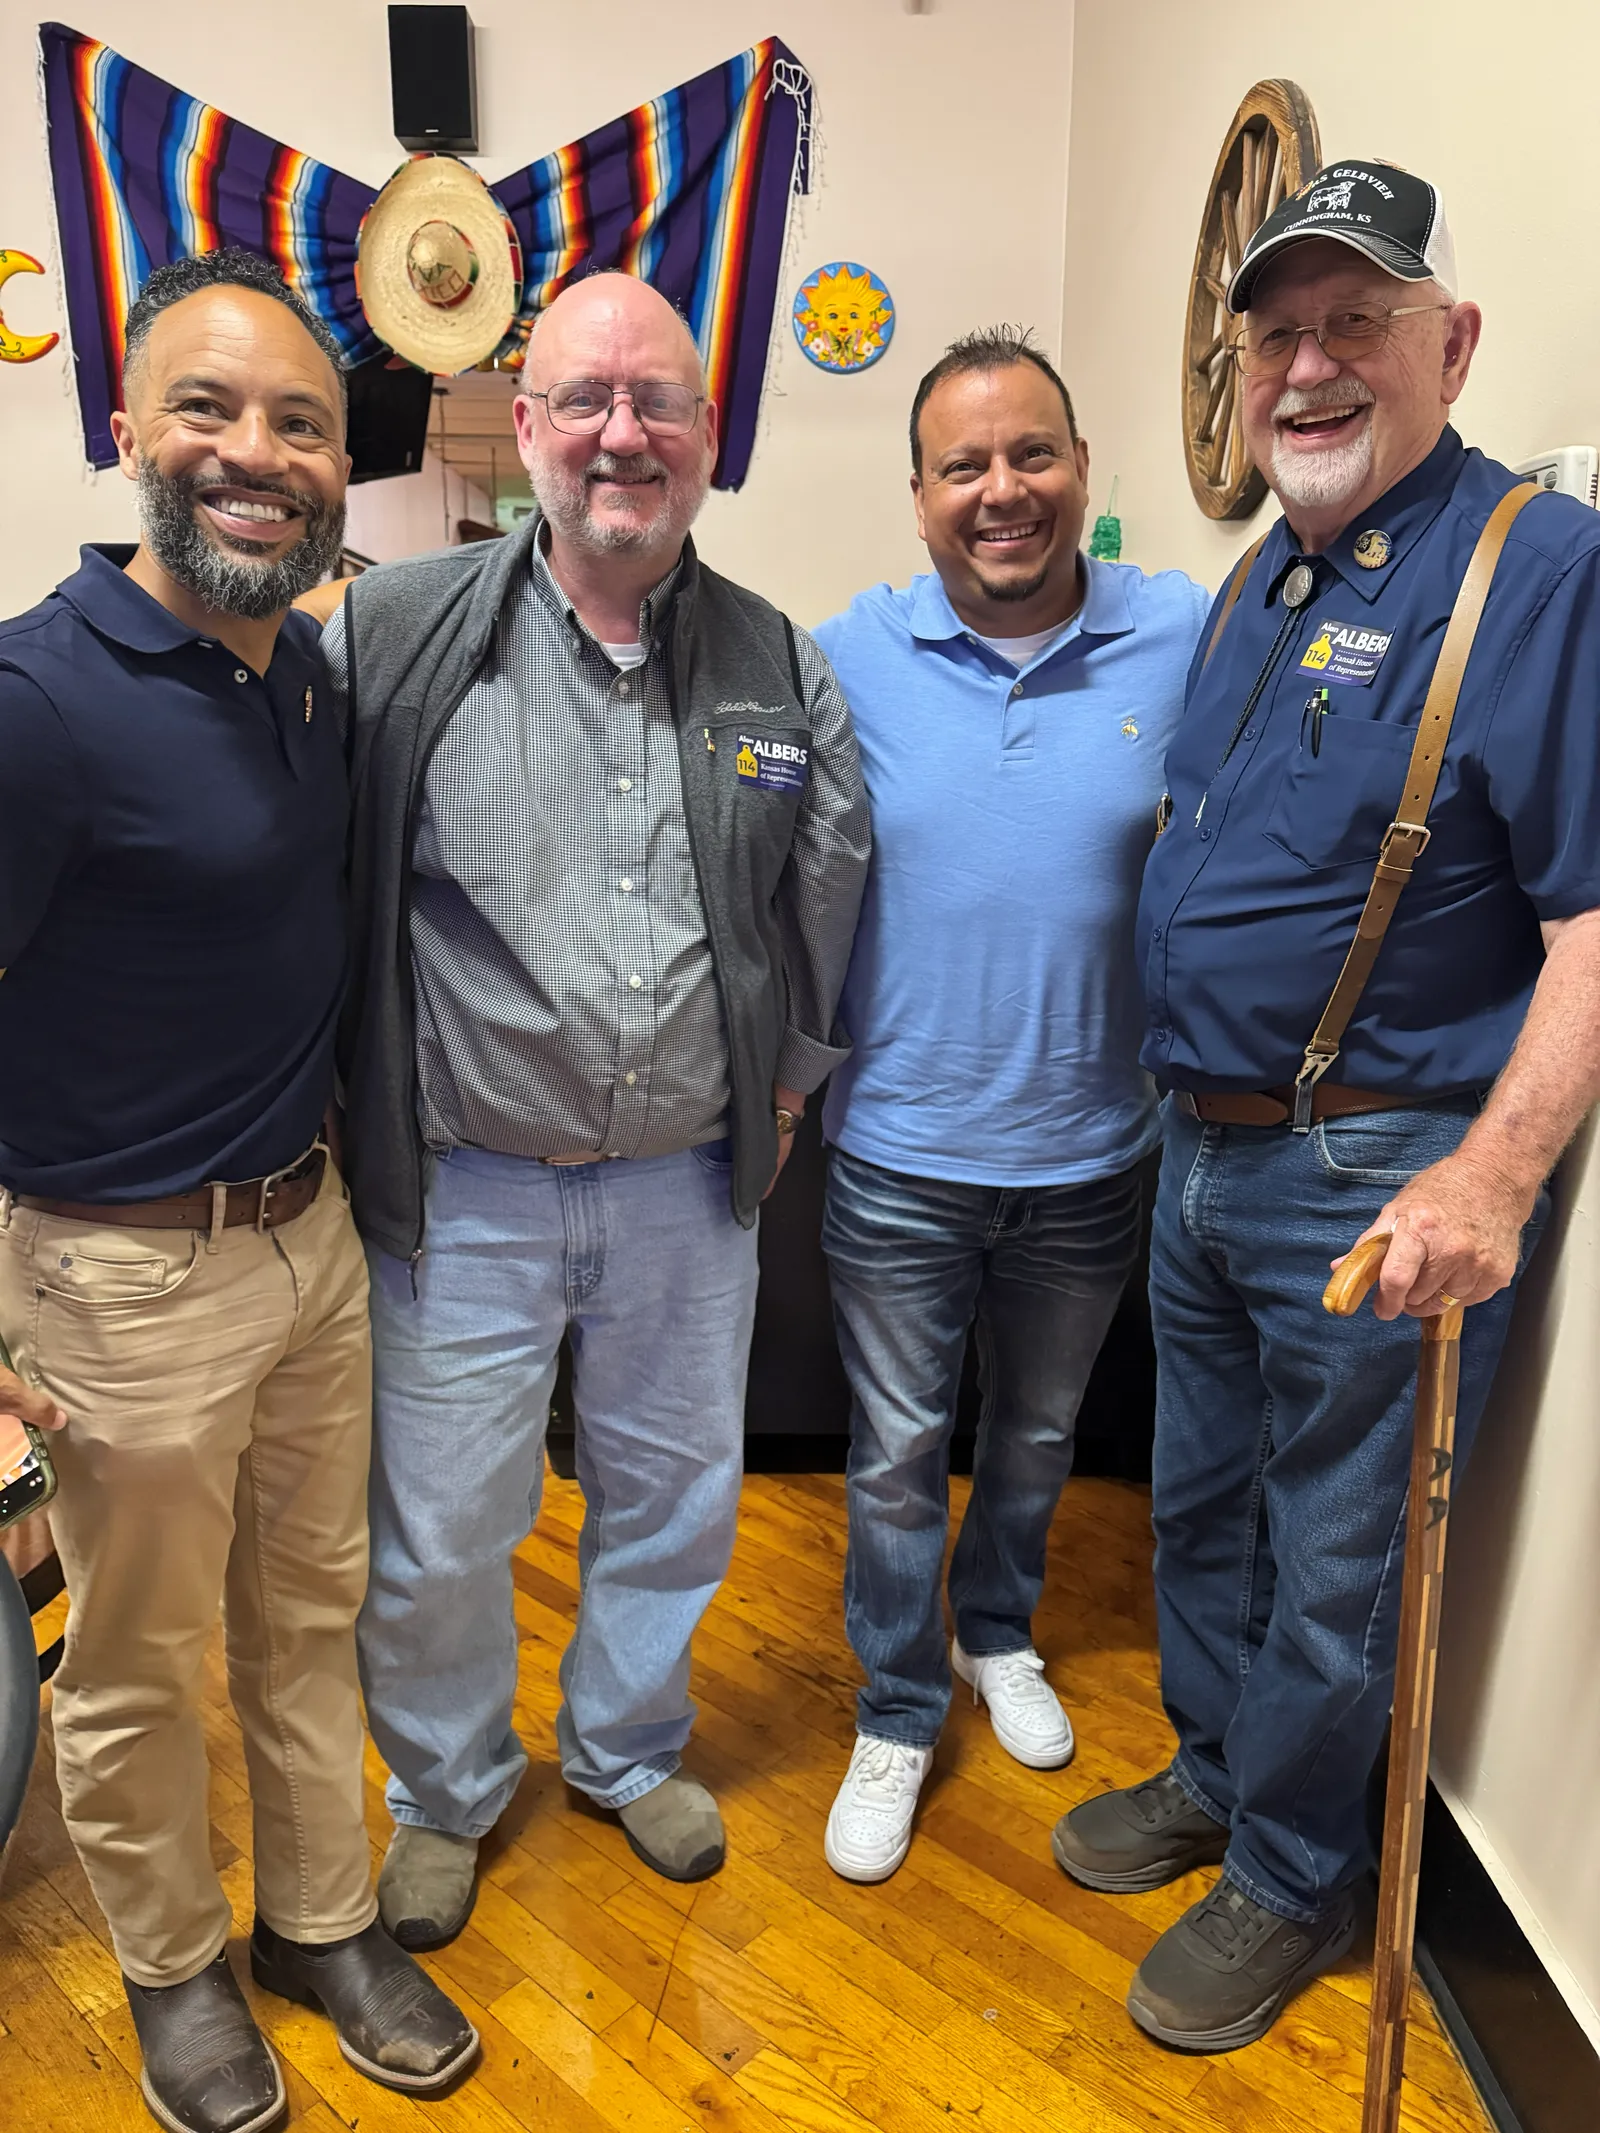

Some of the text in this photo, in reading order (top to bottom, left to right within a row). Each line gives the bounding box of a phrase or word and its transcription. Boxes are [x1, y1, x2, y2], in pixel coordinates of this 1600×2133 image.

[1332, 168, 1395, 201] GELBVIEH
[1356, 213, 1372, 224] KS
[1320, 622, 1340, 634] Alan
[1306, 649, 1325, 664] 114
[1333, 654, 1374, 667] Kansas House
[738, 735, 754, 745] Alan
[753, 739, 808, 765] ALBERS
[738, 759, 756, 773] 114
[760, 763, 780, 773] Kansas
[760, 772, 767, 780] of
